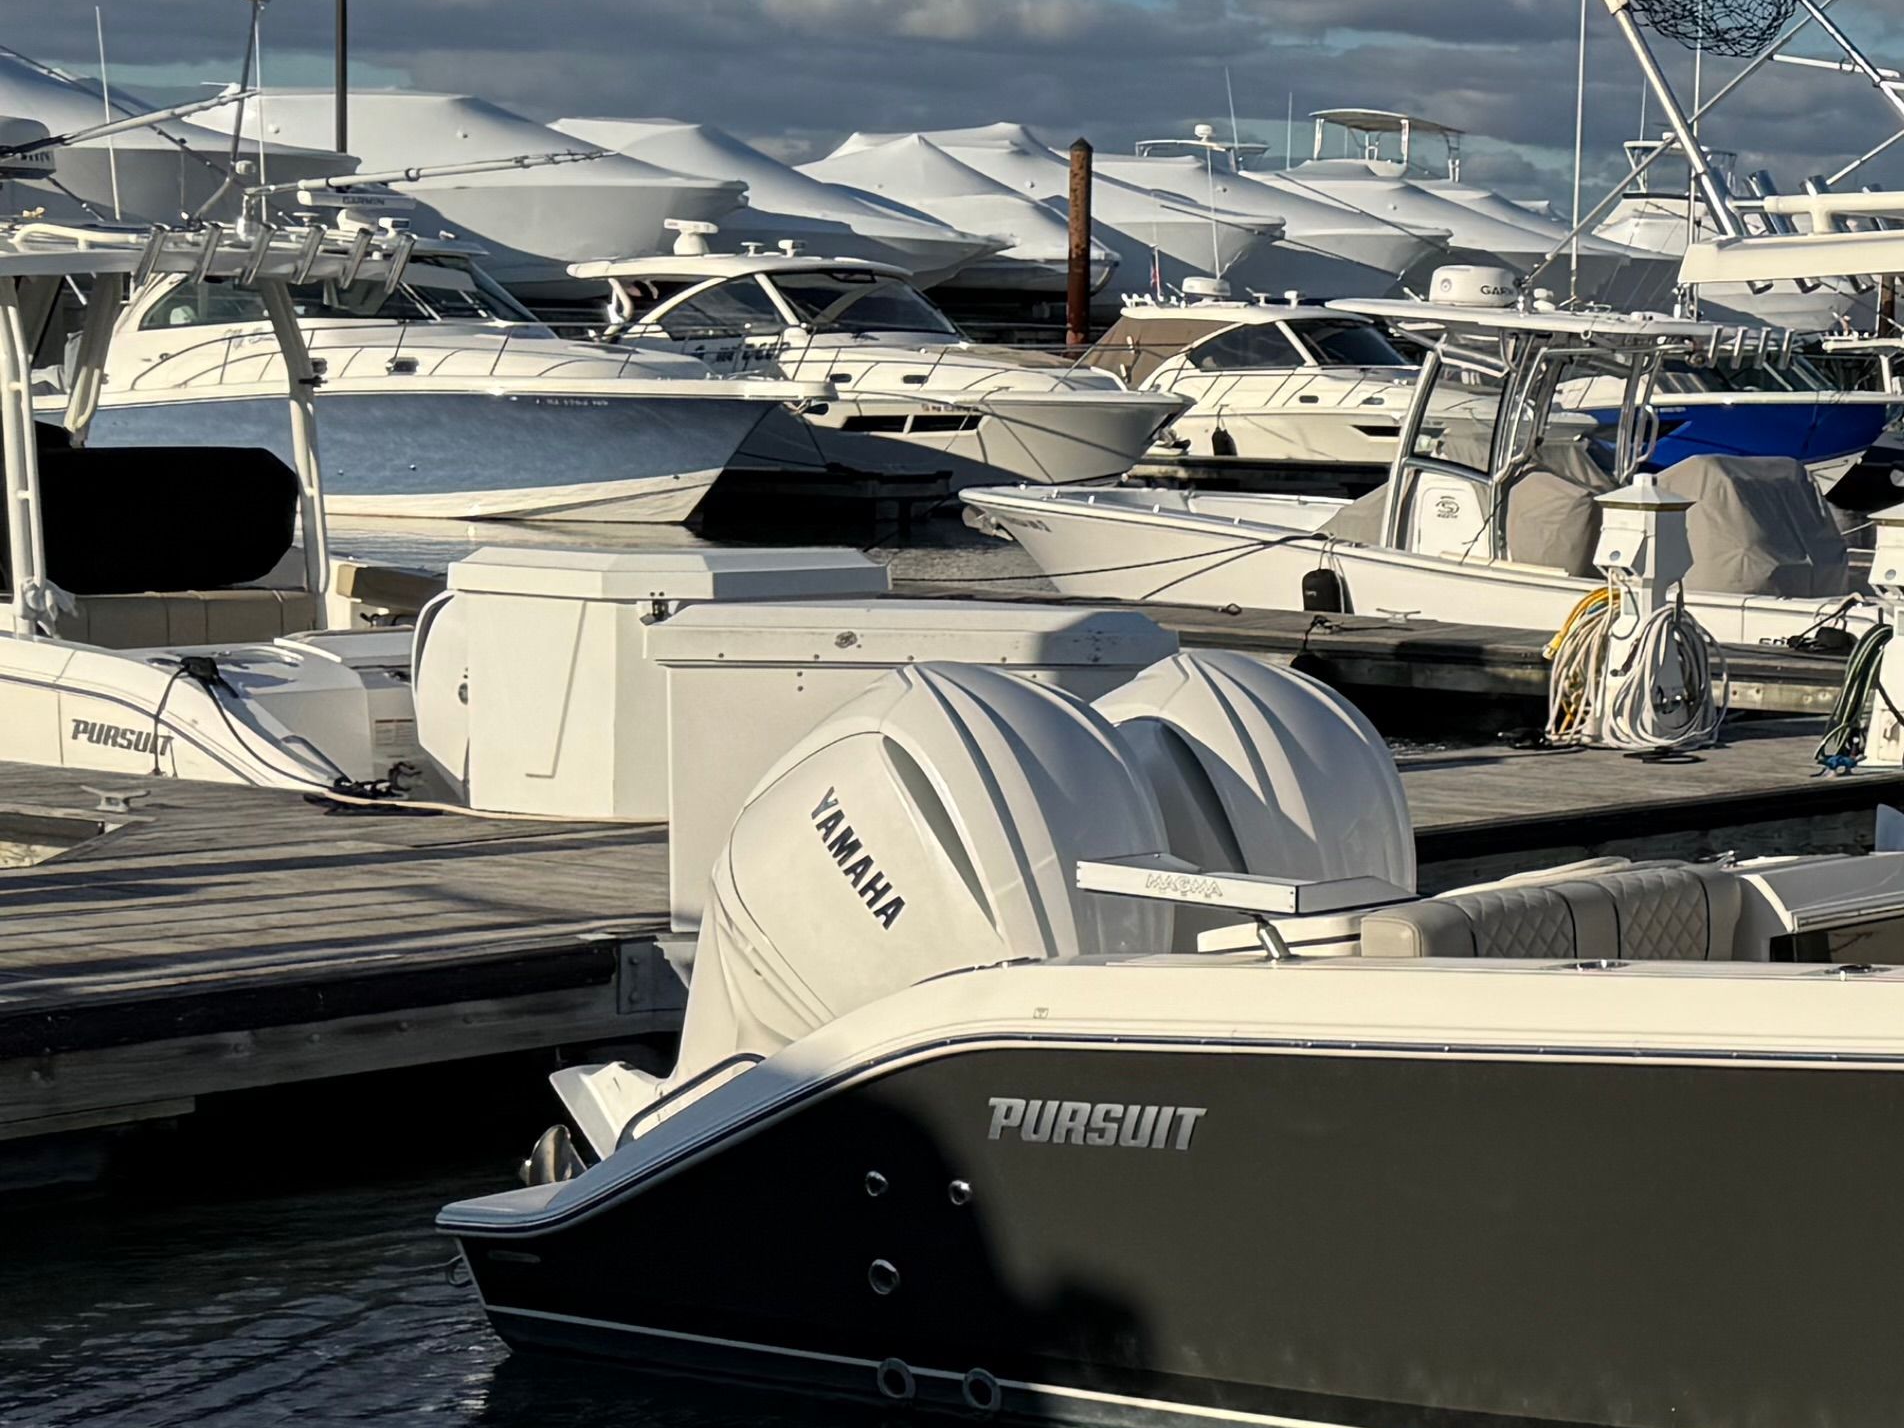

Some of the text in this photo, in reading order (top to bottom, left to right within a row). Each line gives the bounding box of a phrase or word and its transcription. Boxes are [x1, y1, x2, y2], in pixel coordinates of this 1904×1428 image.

[71, 718, 175, 757] PURSUIT
[811, 785, 905, 931] YAMAHA
[988, 1097, 1208, 1151] PURSUIT
